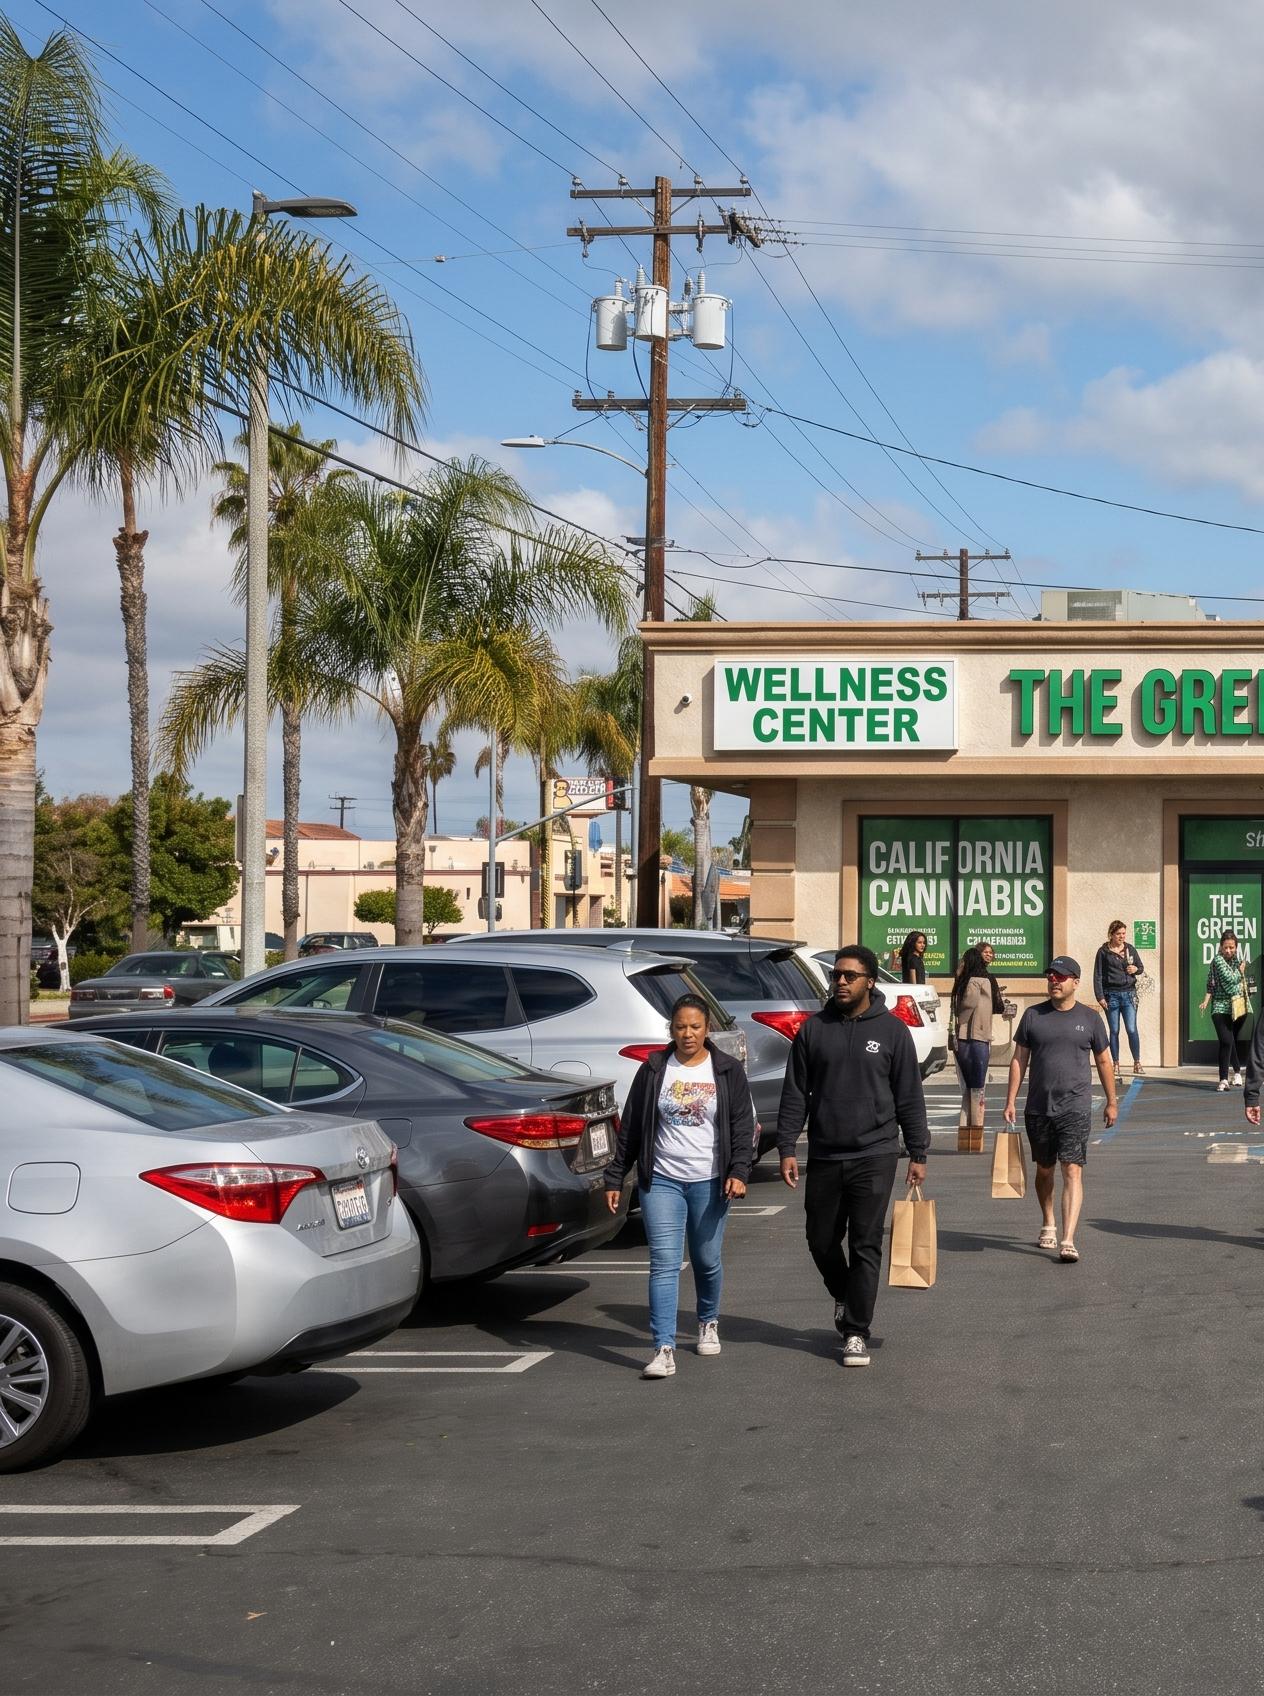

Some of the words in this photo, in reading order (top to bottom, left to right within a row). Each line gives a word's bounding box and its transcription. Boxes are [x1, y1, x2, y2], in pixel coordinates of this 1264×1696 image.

[724, 666, 948, 702] WELLNESS
[1009, 668, 1123, 736] THE
[752, 707, 920, 743] CENTER
[868, 840, 1044, 874] CALIFORNIA
[868, 879, 1045, 917] CANNABIS
[1209, 894, 1243, 916] THE
[1197, 917, 1257, 939] GREEN
